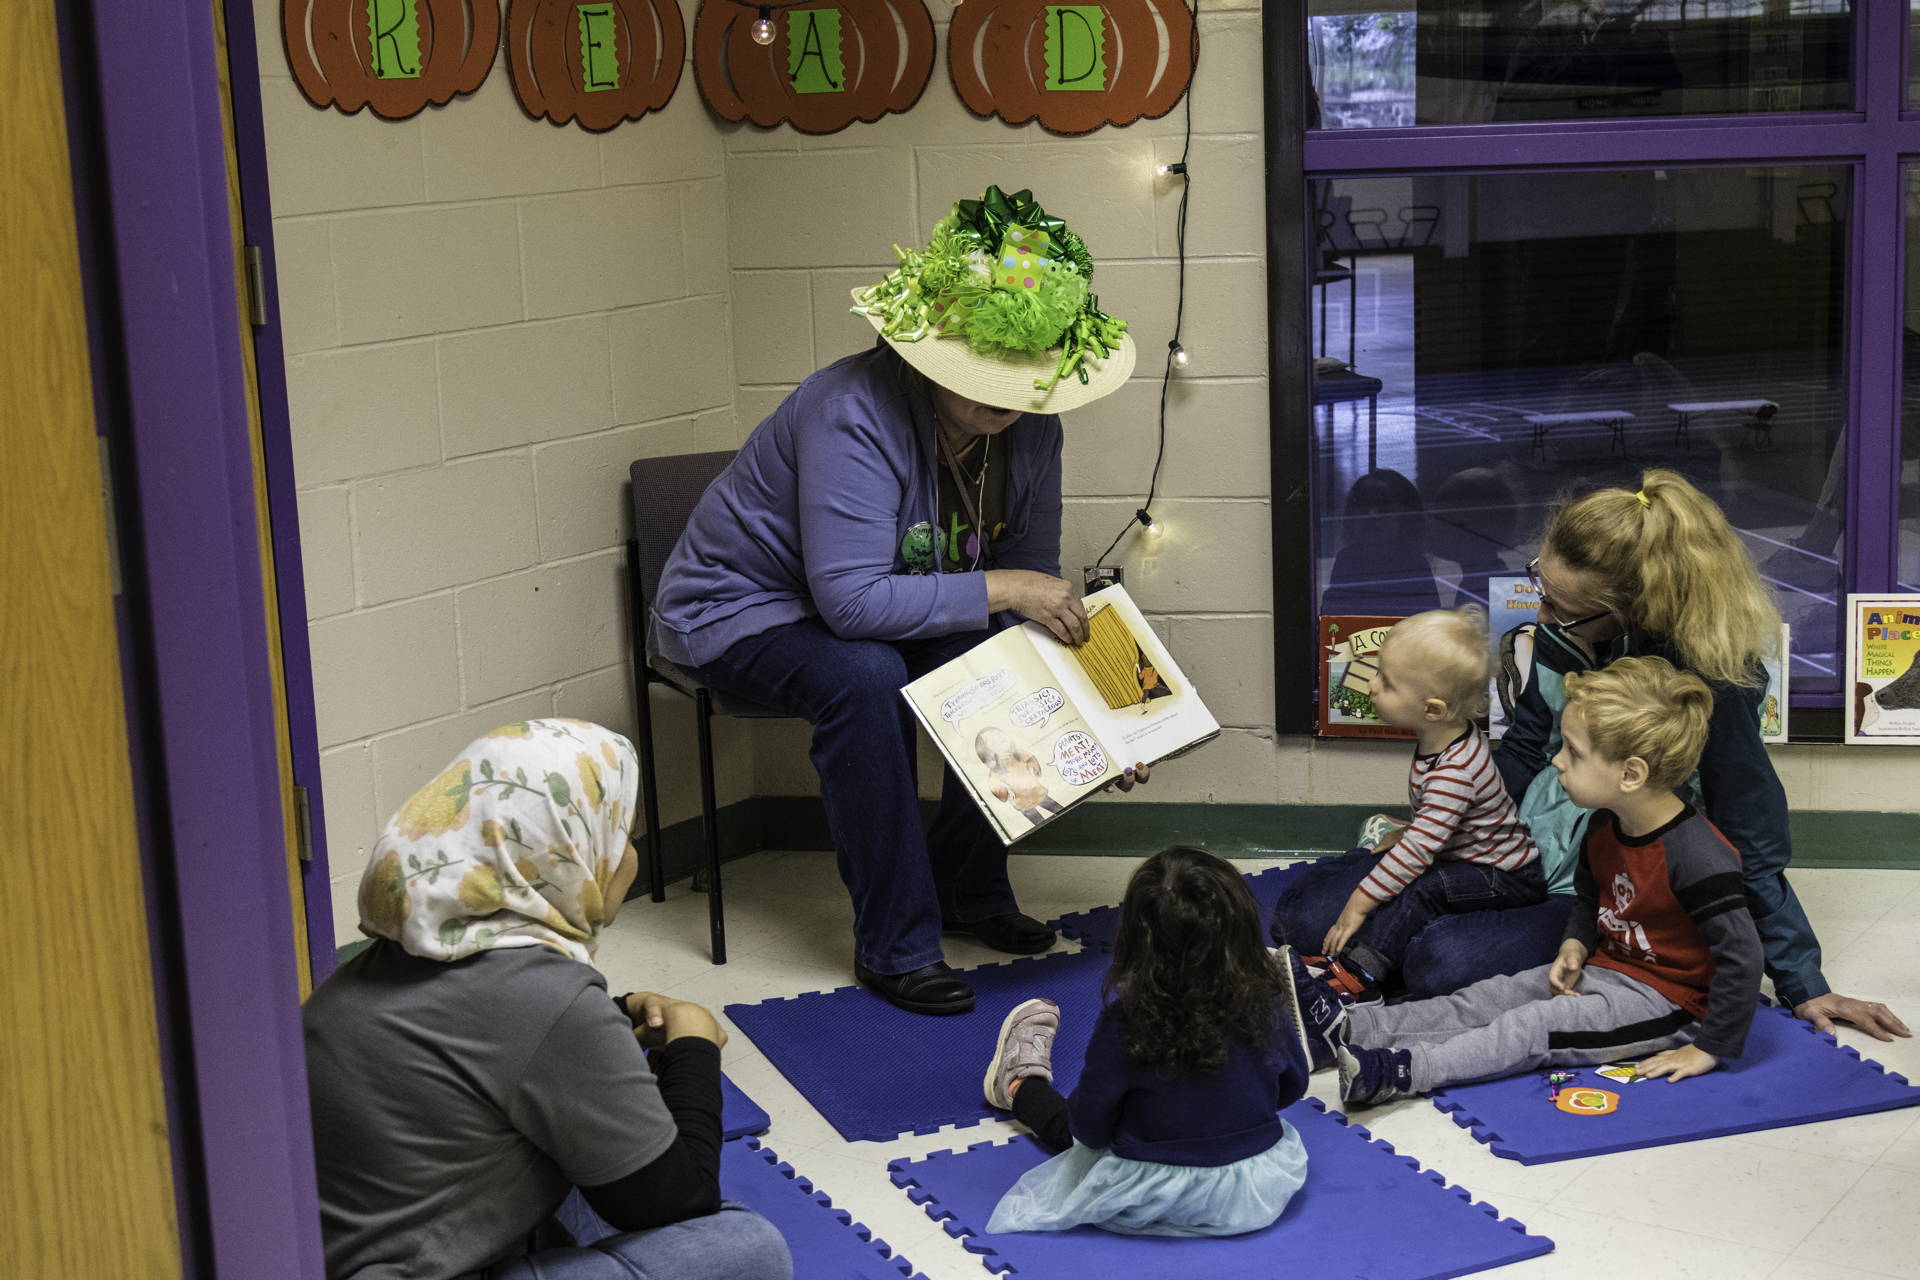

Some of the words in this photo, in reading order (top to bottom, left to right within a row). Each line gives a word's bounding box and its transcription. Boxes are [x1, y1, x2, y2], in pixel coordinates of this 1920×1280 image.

[374, 0, 416, 77] R
[582, 10, 616, 87] E
[790, 11, 839, 88] A
[1056, 9, 1097, 85] D
[1353, 634, 1368, 651] A
[1060, 738, 1090, 760] MEAT!
[1088, 751, 1101, 766] LOTS
[1080, 758, 1105, 783] MEAT!
